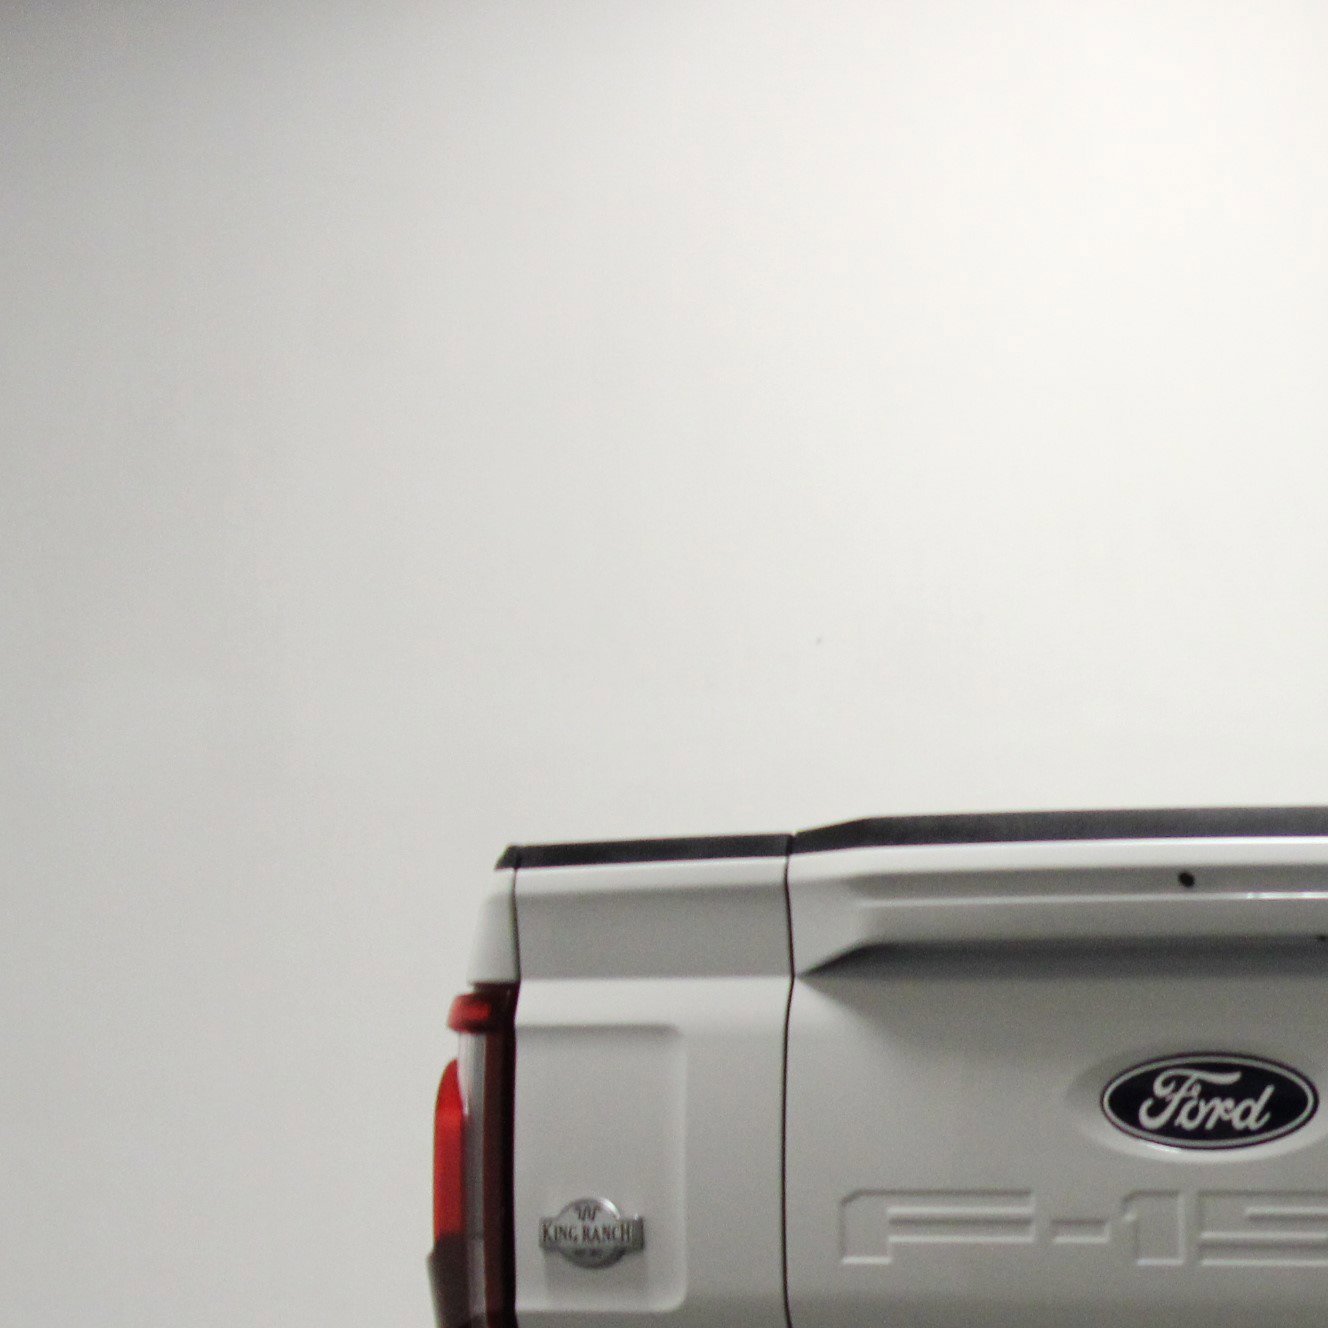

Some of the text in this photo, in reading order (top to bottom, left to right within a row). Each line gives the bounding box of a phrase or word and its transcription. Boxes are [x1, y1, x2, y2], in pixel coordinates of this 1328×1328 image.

[1138, 1068, 1276, 1131] Ford
[542, 1221, 632, 1243] KING RANCH
